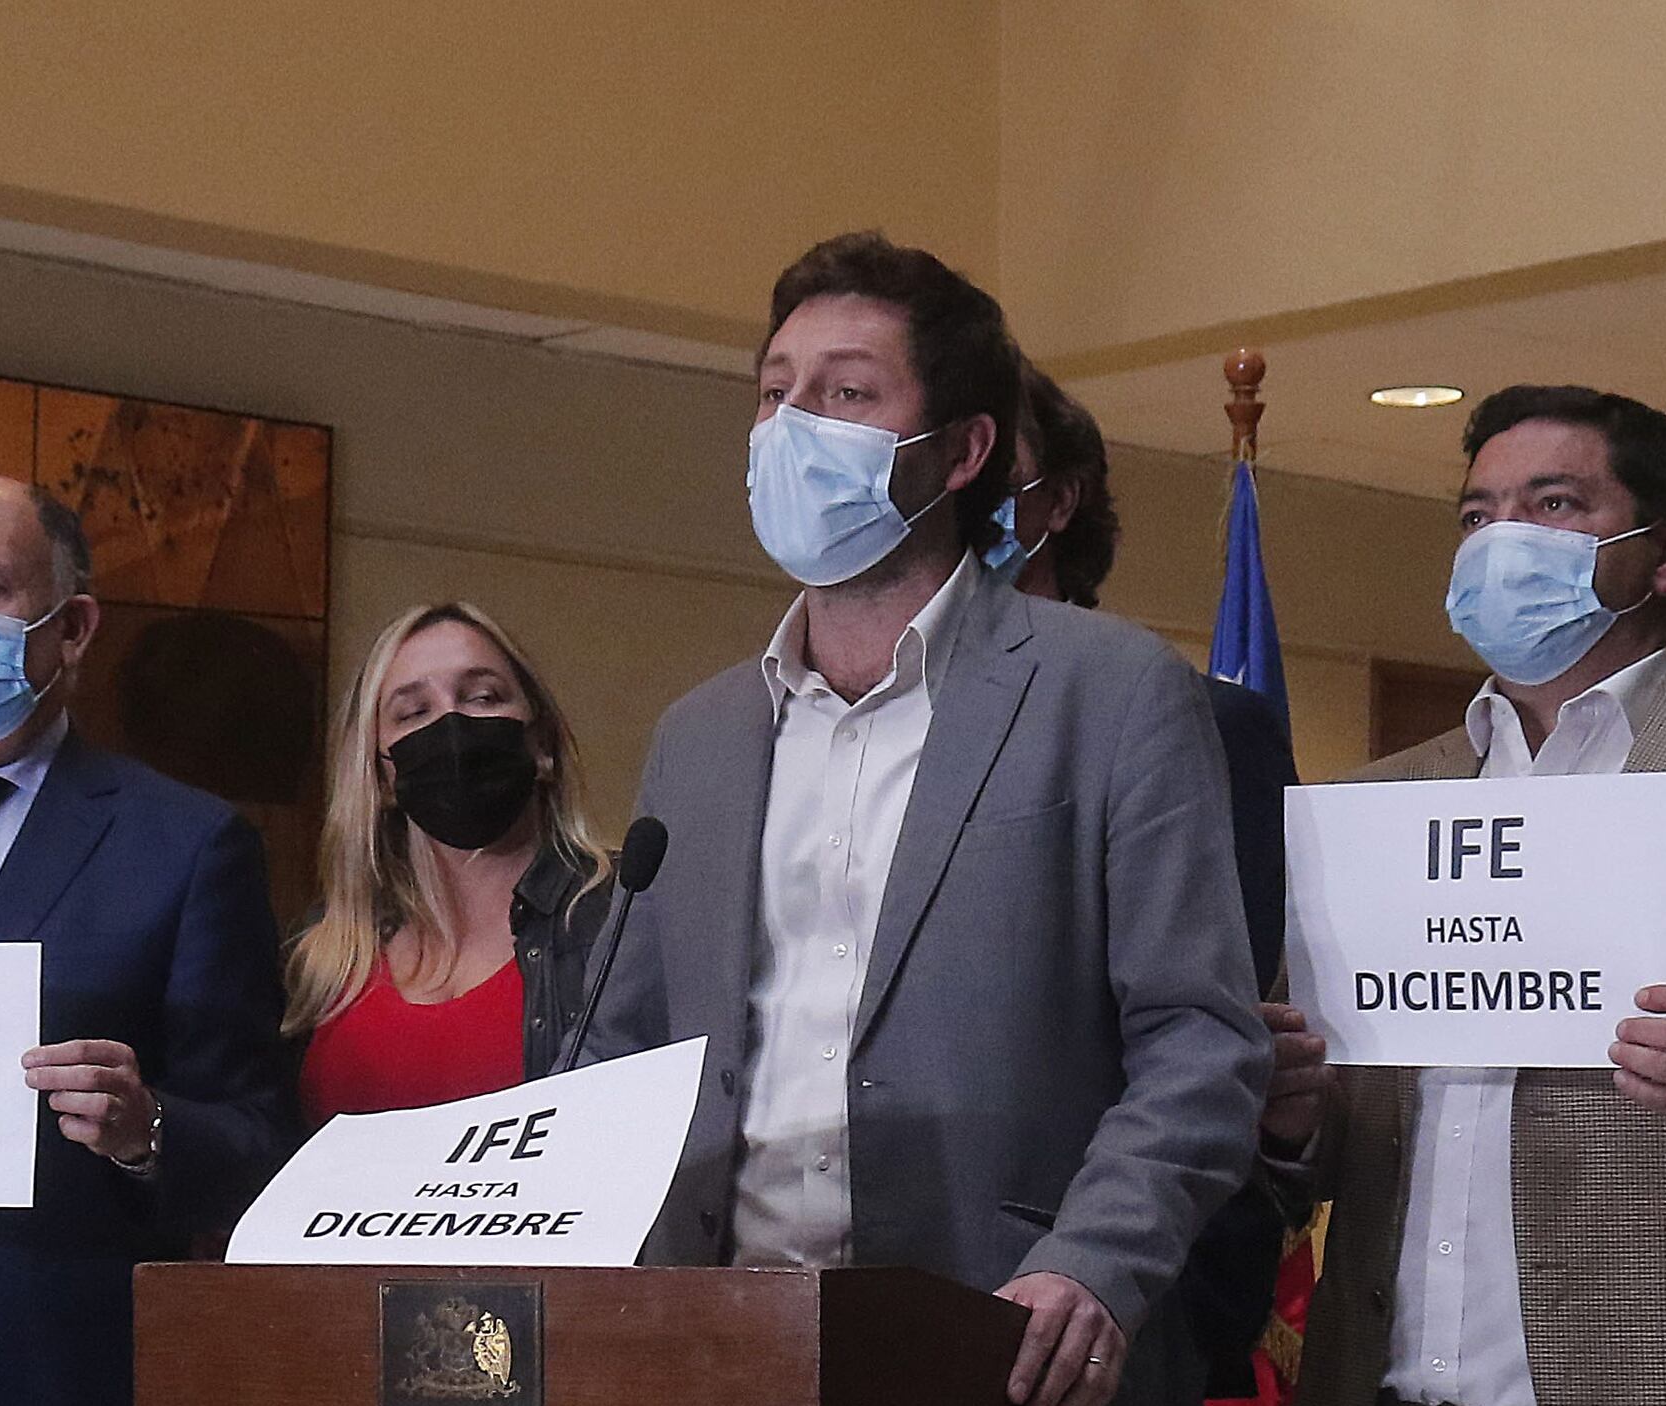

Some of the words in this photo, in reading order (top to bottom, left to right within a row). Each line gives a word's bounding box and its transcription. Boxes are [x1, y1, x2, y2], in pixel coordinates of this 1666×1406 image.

[1426, 816, 1525, 882] IFE
[1425, 915, 1525, 945] HASTA
[1354, 970, 1604, 1012] DICIEMBRE
[444, 1106, 559, 1165] IFE
[413, 1181, 520, 1199] HASTA
[302, 1210, 585, 1239] DICIEMBRE
